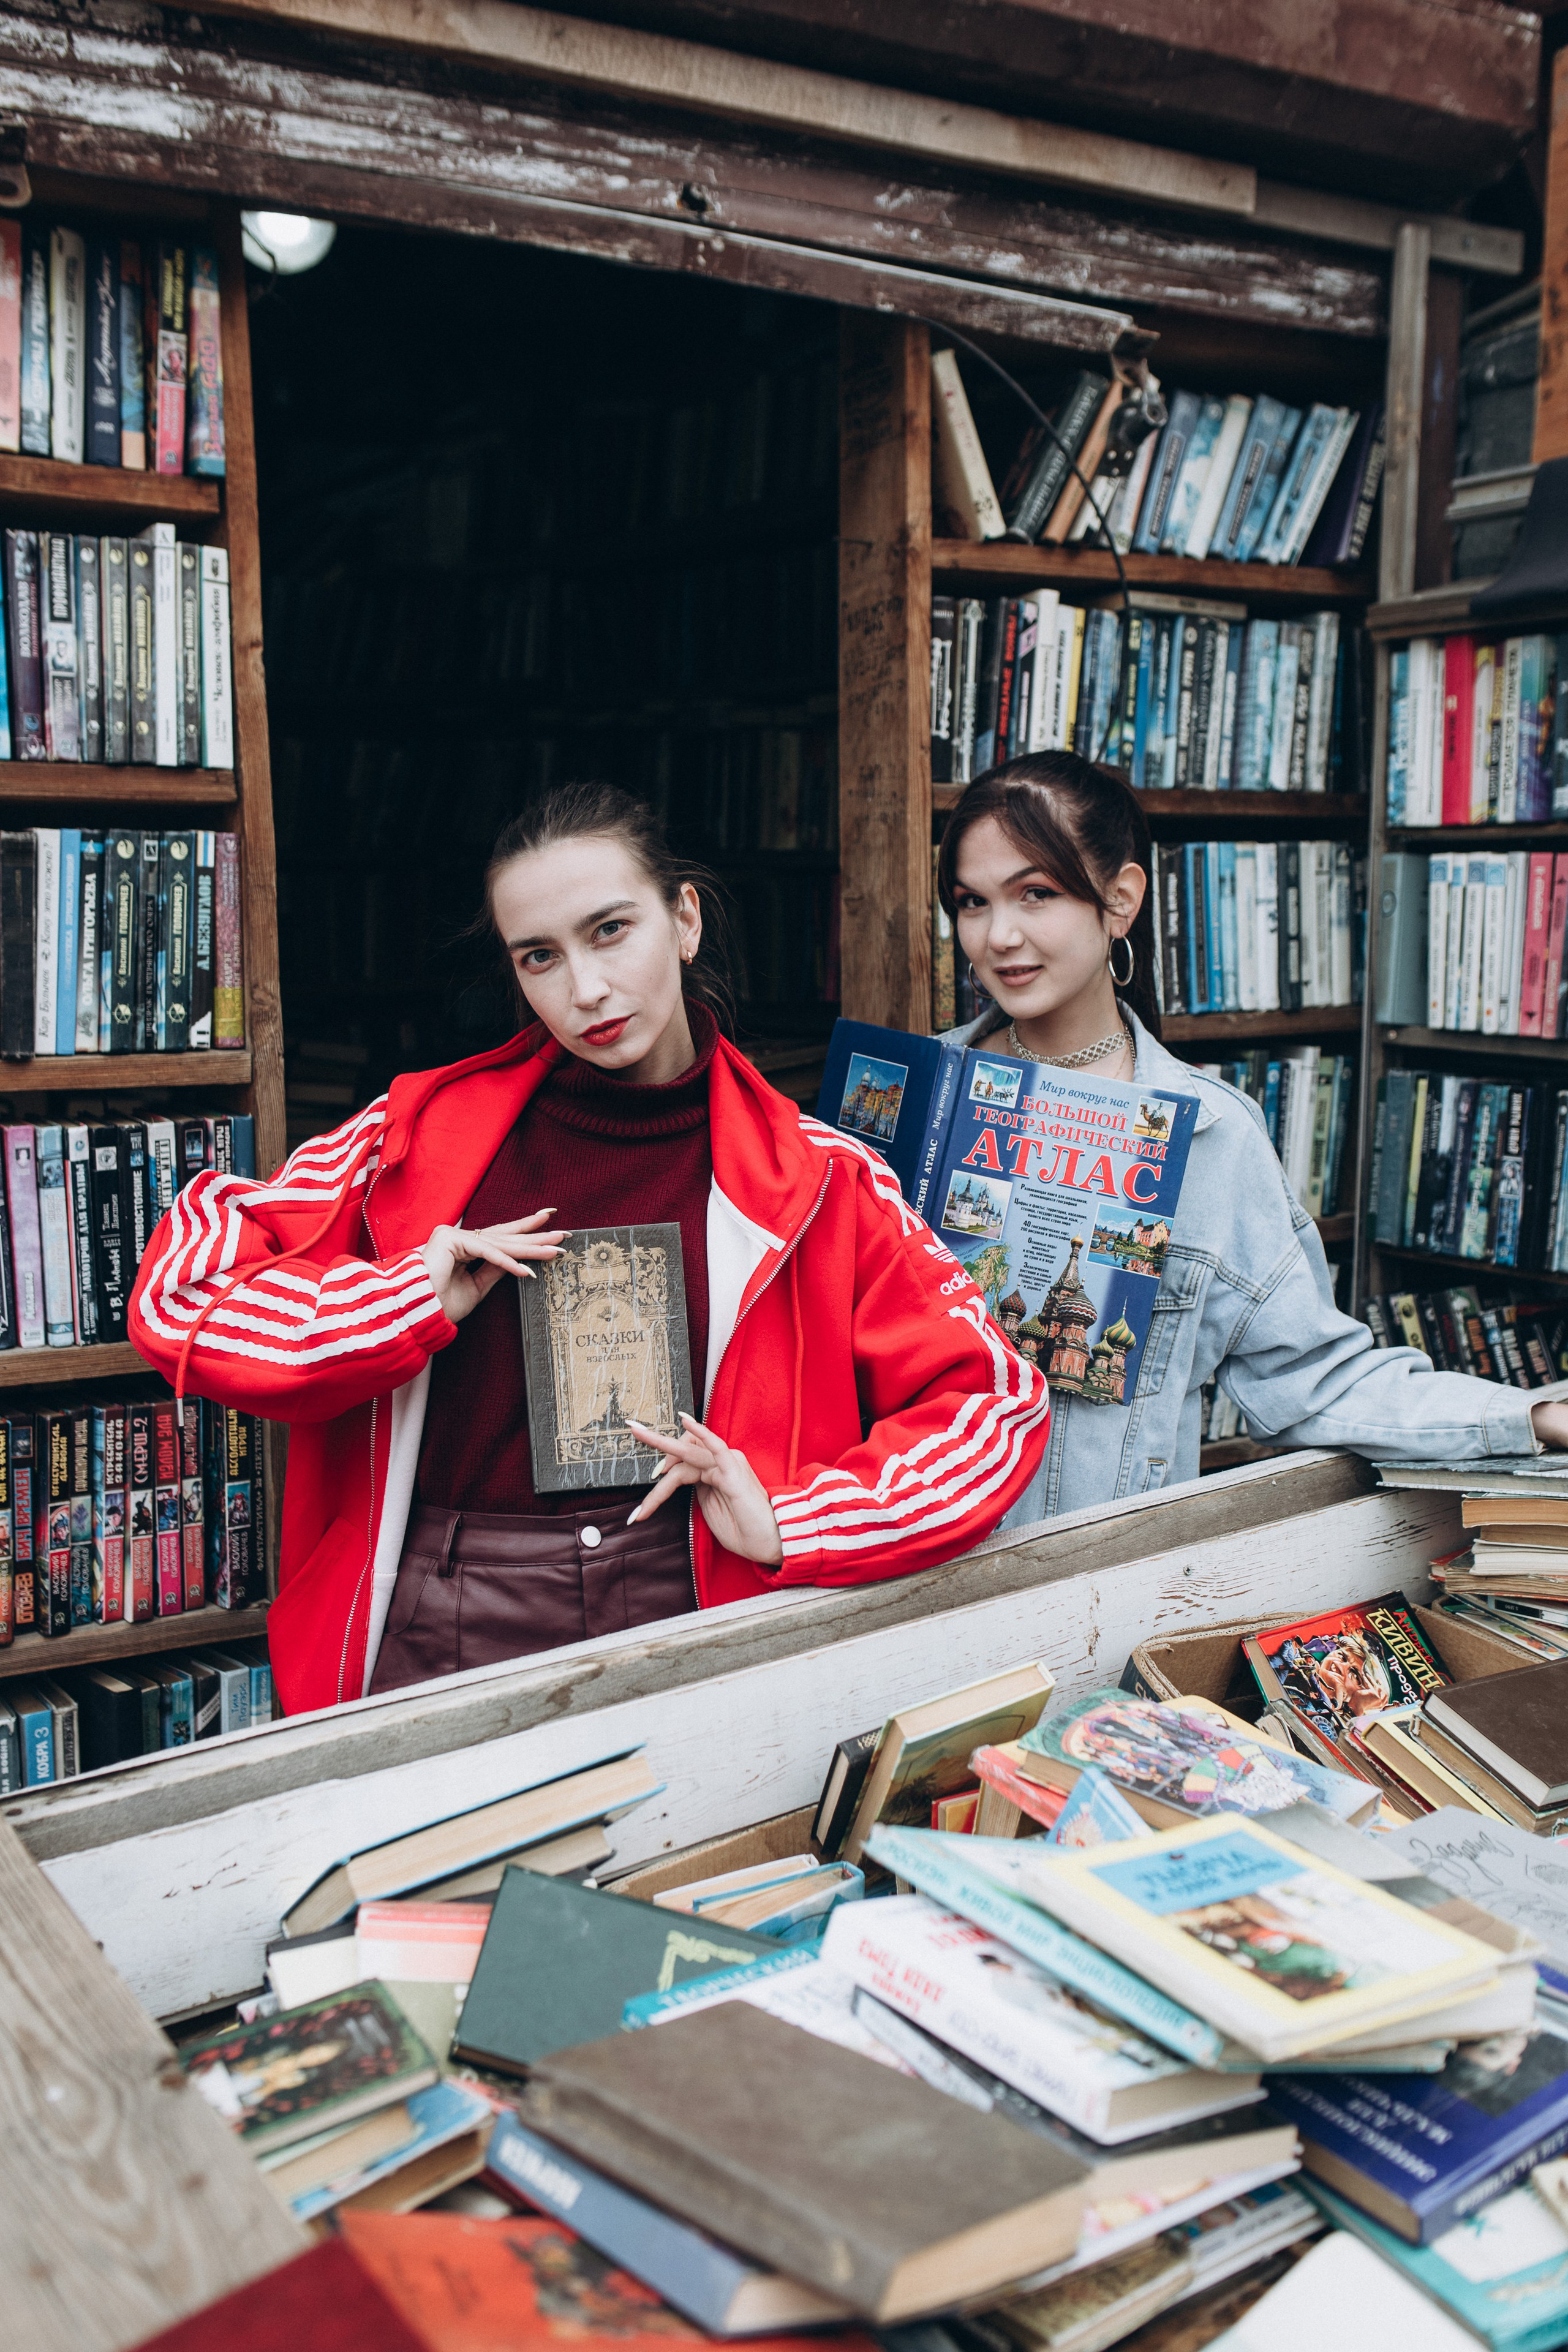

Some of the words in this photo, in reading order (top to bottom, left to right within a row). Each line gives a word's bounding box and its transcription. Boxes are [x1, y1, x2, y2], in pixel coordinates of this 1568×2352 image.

[83, 873, 96, 959] ГРИГОРЬЕВА
[119, 885, 128, 935] ГОЛОВАЧЕВ
[173, 886, 183, 935] ГОЛОВАЧЕВ
[84, 961, 95, 1006] ОЛЬГА
[932, 1109, 943, 1130] Мир
[938, 1081, 950, 1108] вокруг
[1021, 1095, 1128, 1132] БОЛЬШОЙ
[1039, 1080, 1066, 1096] Мир
[1068, 1089, 1107, 1106] вокруг
[1110, 1099, 1129, 1109] нас
[973, 1105, 1168, 1161] ГЕОГРАФИЧЕСКИЙ
[924, 1139, 938, 1174] АТЛАС
[962, 1127, 1162, 1204] АТЛАС
[76, 1164, 87, 1209] БРАТВЫ
[1021, 1183, 1046, 1195] Развивающая
[80, 1212, 89, 1234] ДЛЯ
[134, 1170, 145, 1264] ПРОТИВОСТОЯНИЕ
[1031, 1225, 1060, 1234] географических
[1037, 1210, 1068, 1220] государственный
[80, 1236, 91, 1291] ЛОХОТРОН
[1028, 1238, 1047, 1246] Основные
[940, 1268, 974, 1295] adid
[575, 1330, 646, 1348] СКАЗКИ
[586, 1352, 636, 1363] ВЗРОСЛЫХ
[157, 1414, 173, 1438] ЗЛА
[227, 1409, 239, 1476] АБСОЛЮТНЫЙ
[238, 1426, 247, 1457] ИГРОК
[106, 1419, 115, 1485] ИСТРЕБИТЕЛЬ
[115, 1418, 124, 1483] ЗАКОНА
[133, 1417, 148, 1483] СМЕРШ-2
[158, 1440, 174, 1479] ИЗЛОМ
[14, 1467, 31, 1527] ВРЕМЕН
[15, 1529, 32, 1561] БИЧ
[1, 1562, 9, 1616] ГОЛОВАЧЕВ
[1369, 1608, 1440, 1689] КИВИН
[1393, 1608, 1434, 1664] АНДРЕЙ
[1387, 1655, 1421, 1704] Прода
[34, 1727, 49, 1738] 3
[36, 1740, 50, 1779] КОБРА
[1348, 2074, 1454, 2146] МАЛЬЧИКО
